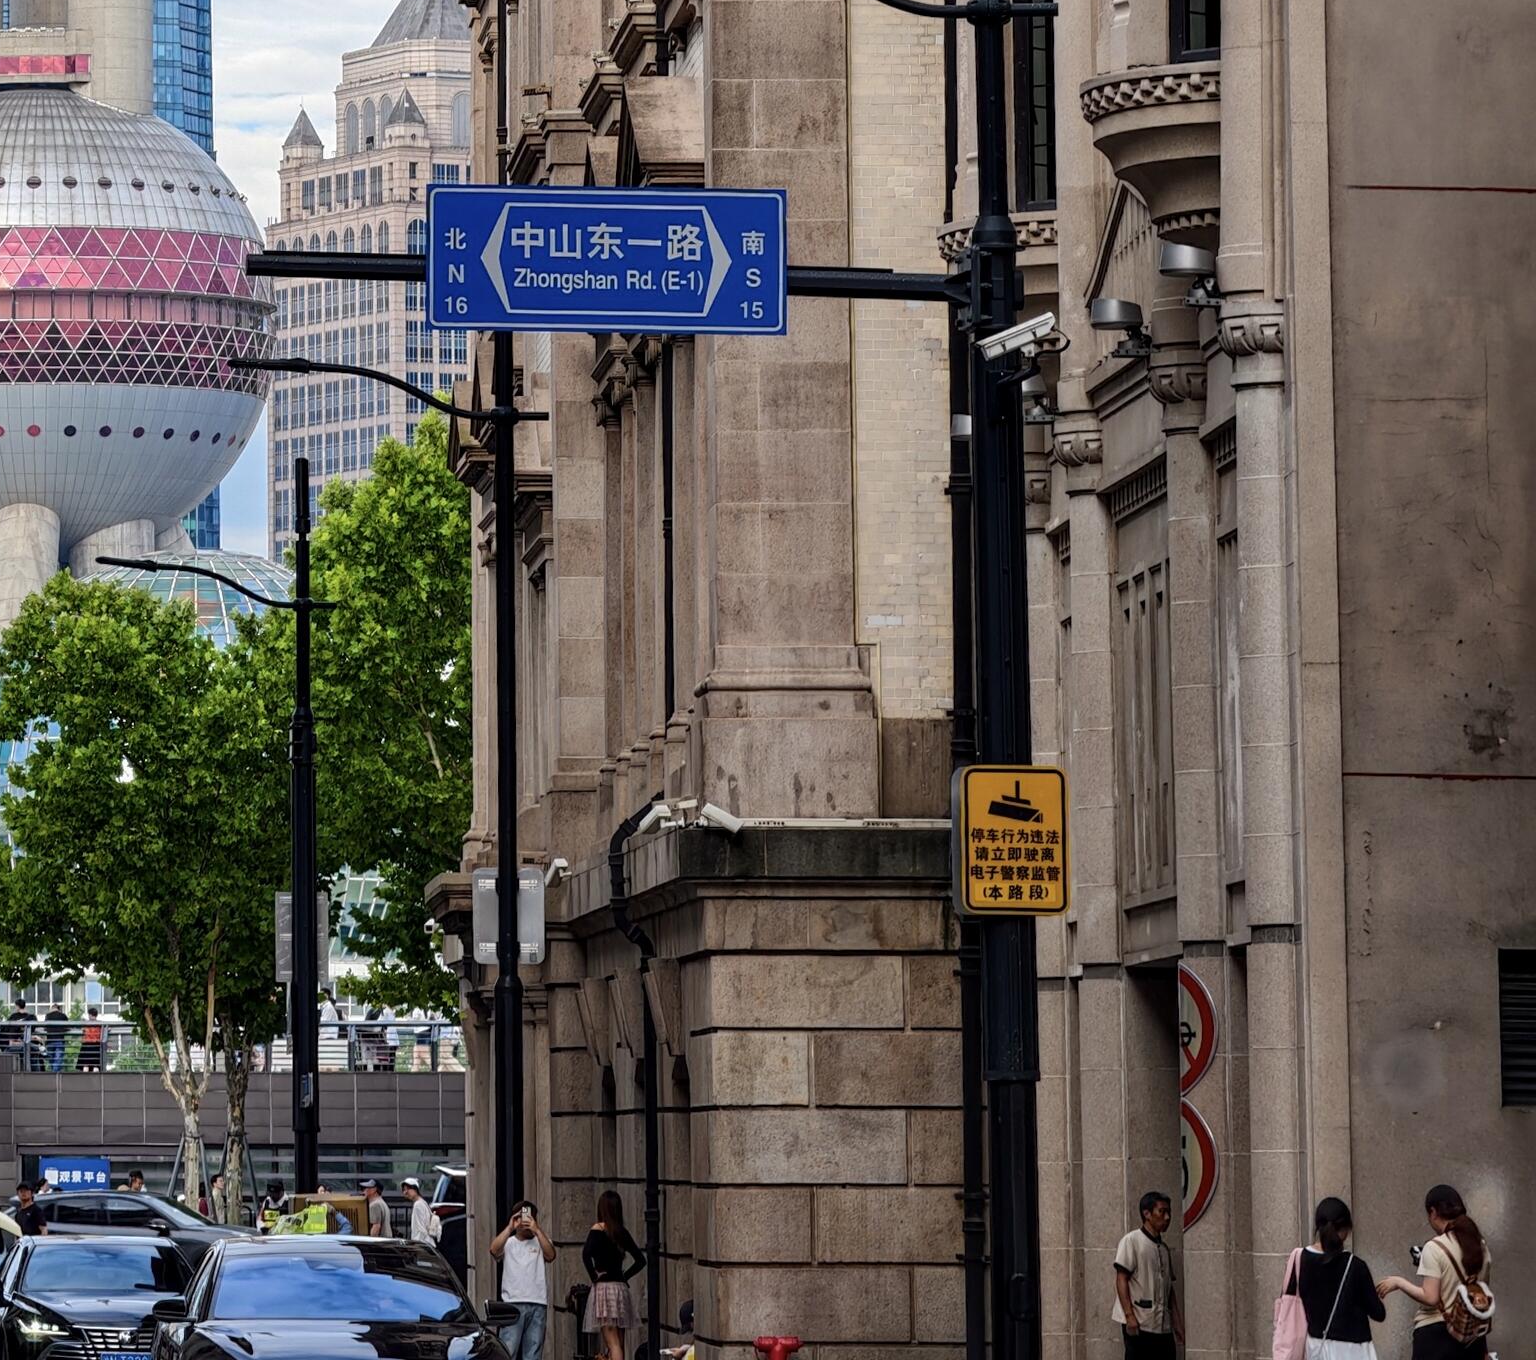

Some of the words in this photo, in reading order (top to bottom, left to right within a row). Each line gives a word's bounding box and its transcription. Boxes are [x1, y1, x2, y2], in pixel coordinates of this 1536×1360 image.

[444, 227, 467, 250] 北
[511, 221, 704, 261] 中山东一路
[741, 230, 765, 256] 南
[448, 263, 465, 284] N
[513, 267, 618, 294] Zhongshan
[626, 269, 657, 290] Rd.
[661, 270, 704, 296] (E-1)
[746, 267, 762, 288] S
[444, 296, 469, 315] 16
[740, 300, 764, 319] 15
[971, 828, 1060, 844] 停车行为违法
[975, 846, 1055, 862] 请立即驶离
[970, 864, 1060, 882] 电子警察监管
